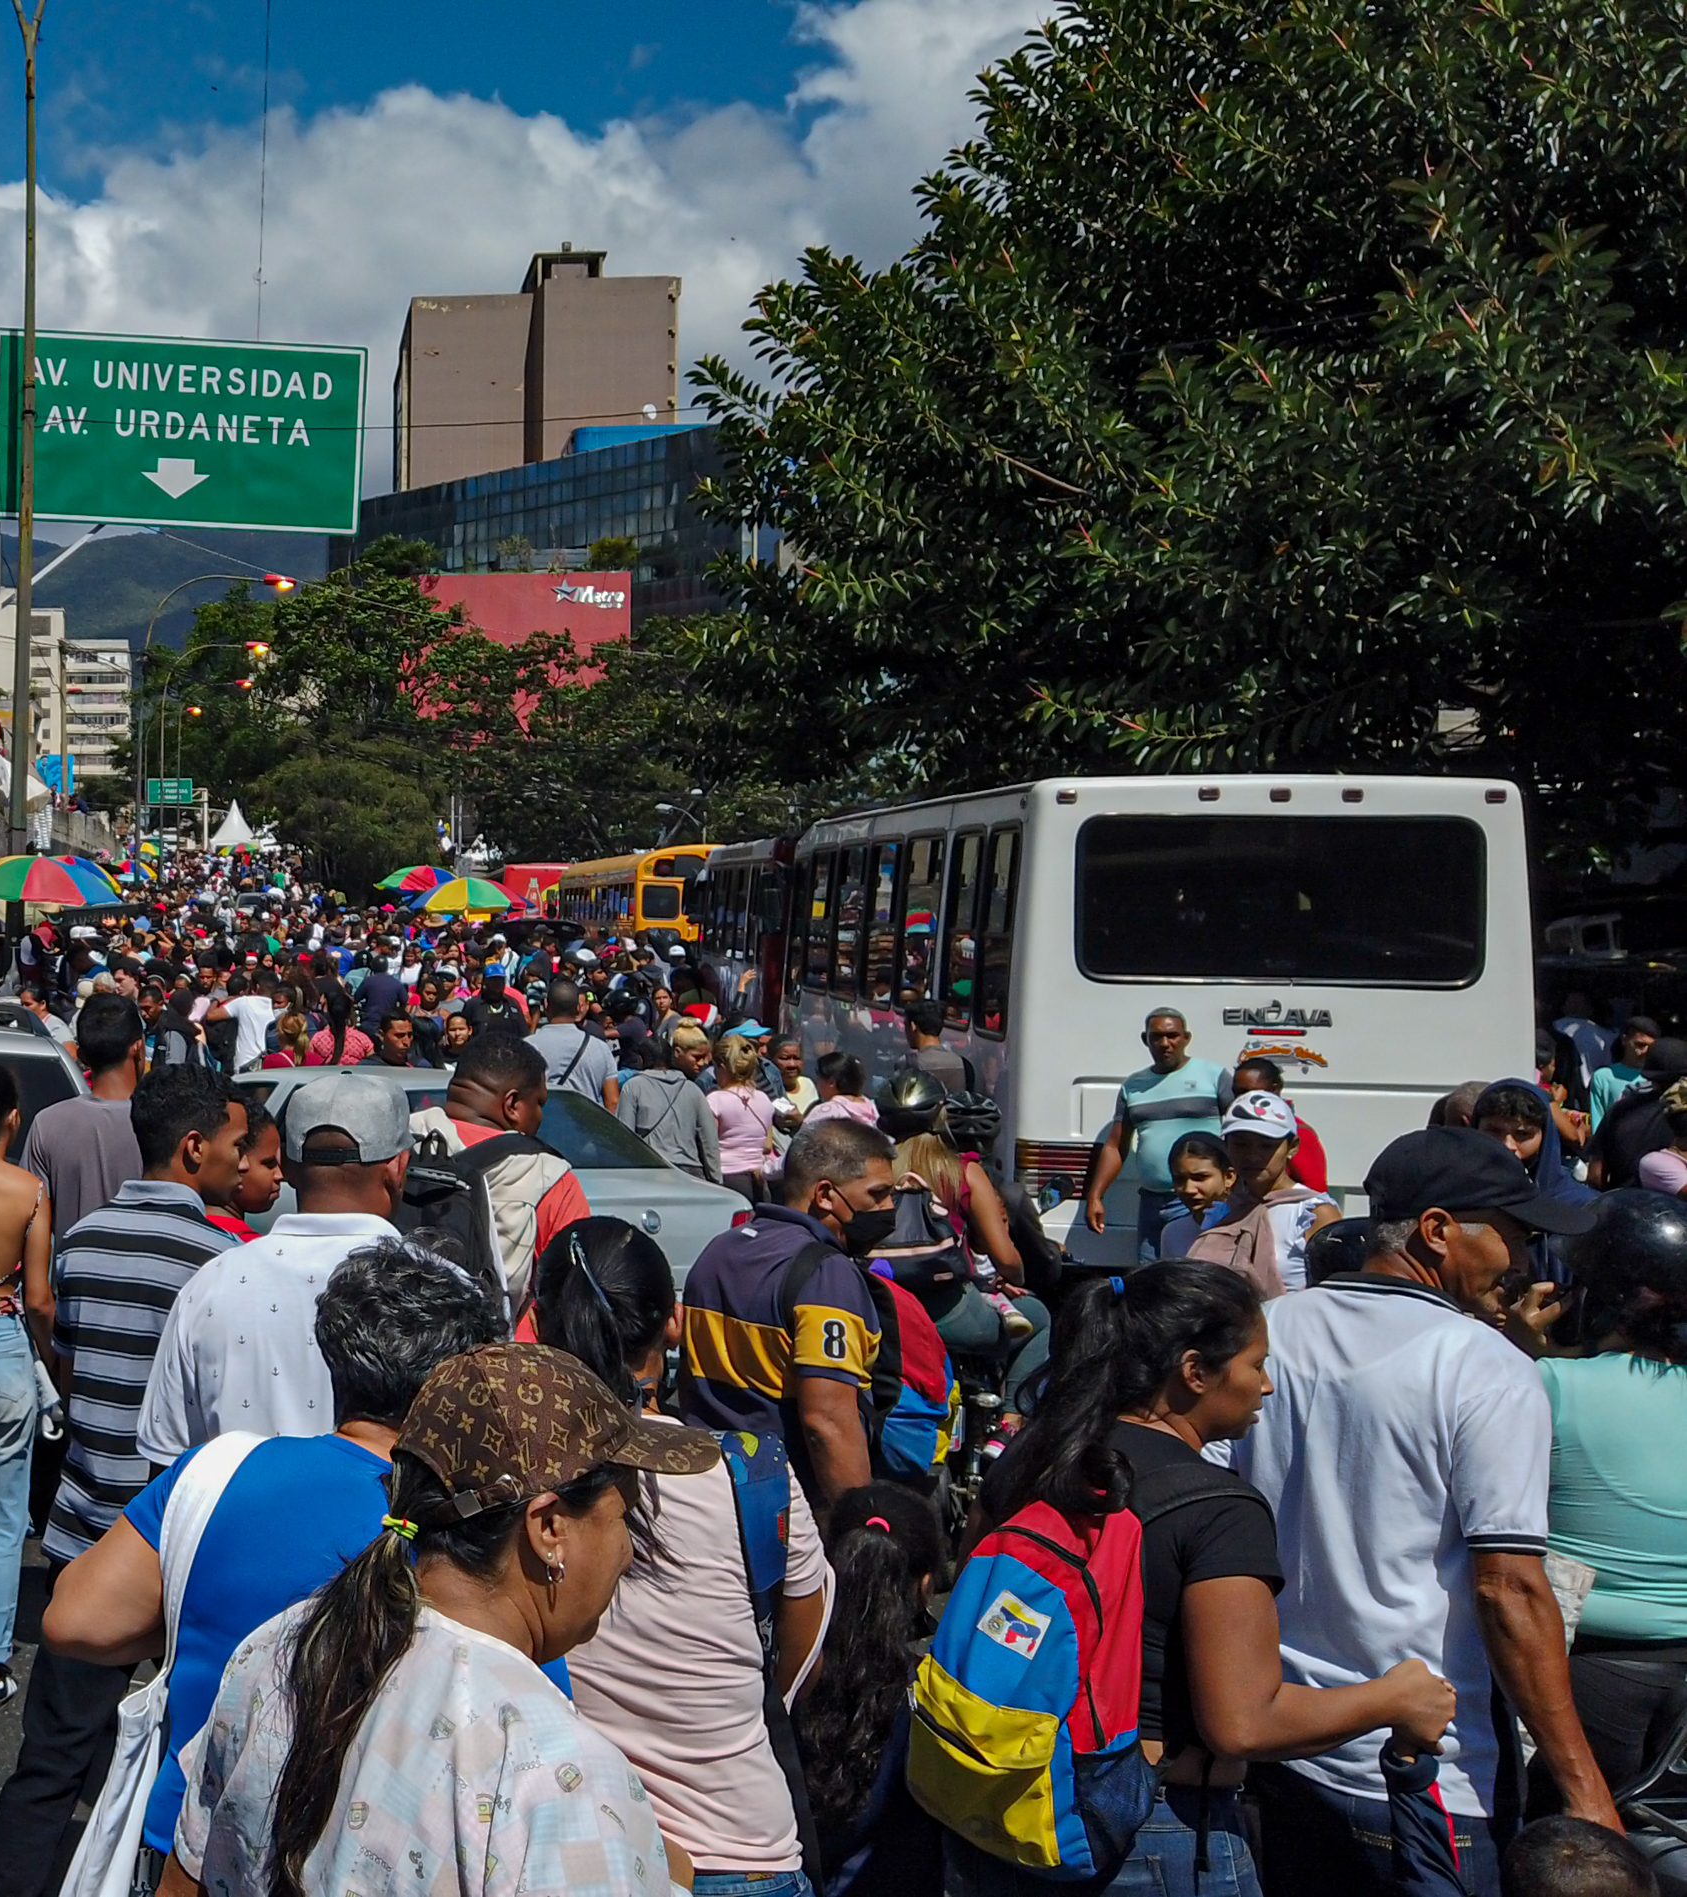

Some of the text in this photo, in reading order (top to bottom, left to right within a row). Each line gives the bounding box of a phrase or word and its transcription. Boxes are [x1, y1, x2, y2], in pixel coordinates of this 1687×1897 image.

[32, 356, 333, 400] AV. UNIVERSIDAD
[42, 405, 311, 447] AV. URDANETA
[822, 1318, 847, 1362] 8
